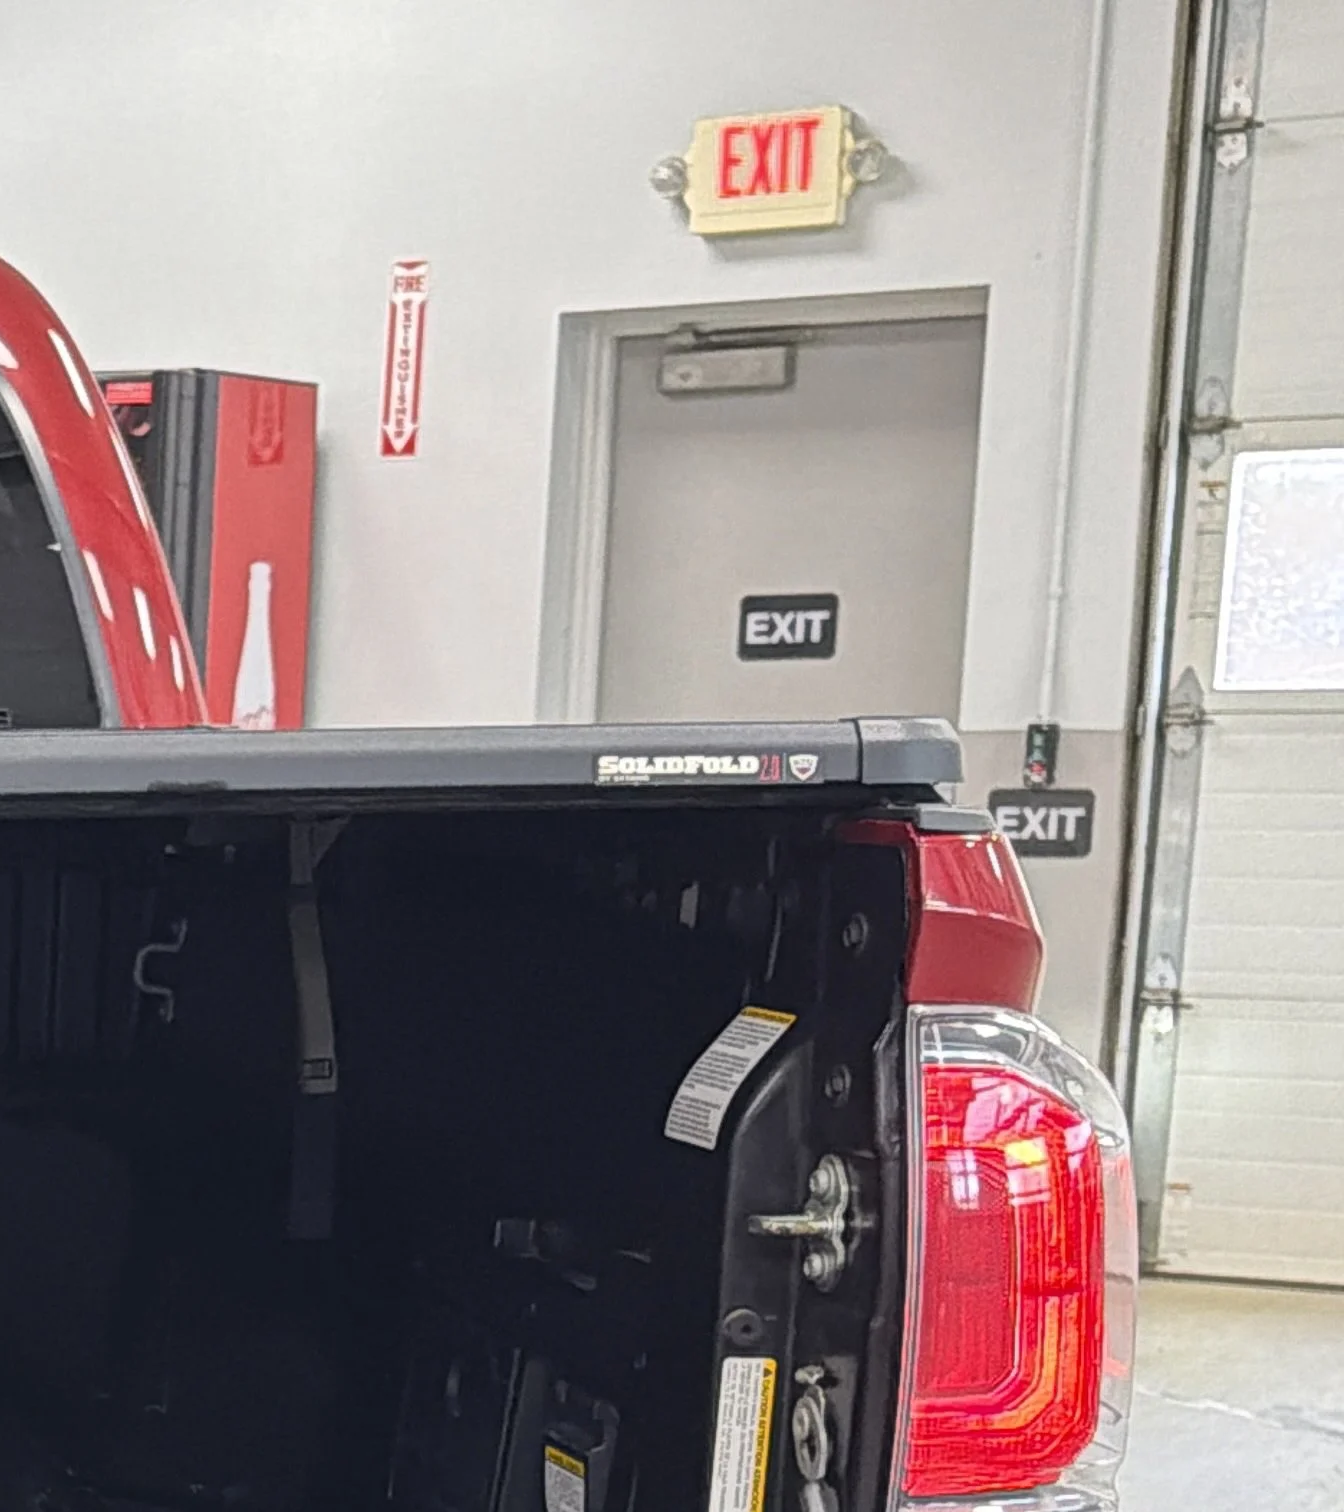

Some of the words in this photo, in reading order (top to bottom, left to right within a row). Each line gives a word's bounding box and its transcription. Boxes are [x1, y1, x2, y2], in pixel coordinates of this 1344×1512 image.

[717, 119, 820, 198] EXIT
[393, 274, 426, 293] FIRE
[746, 610, 830, 644] EXIT
[996, 806, 1086, 841] EXIT
